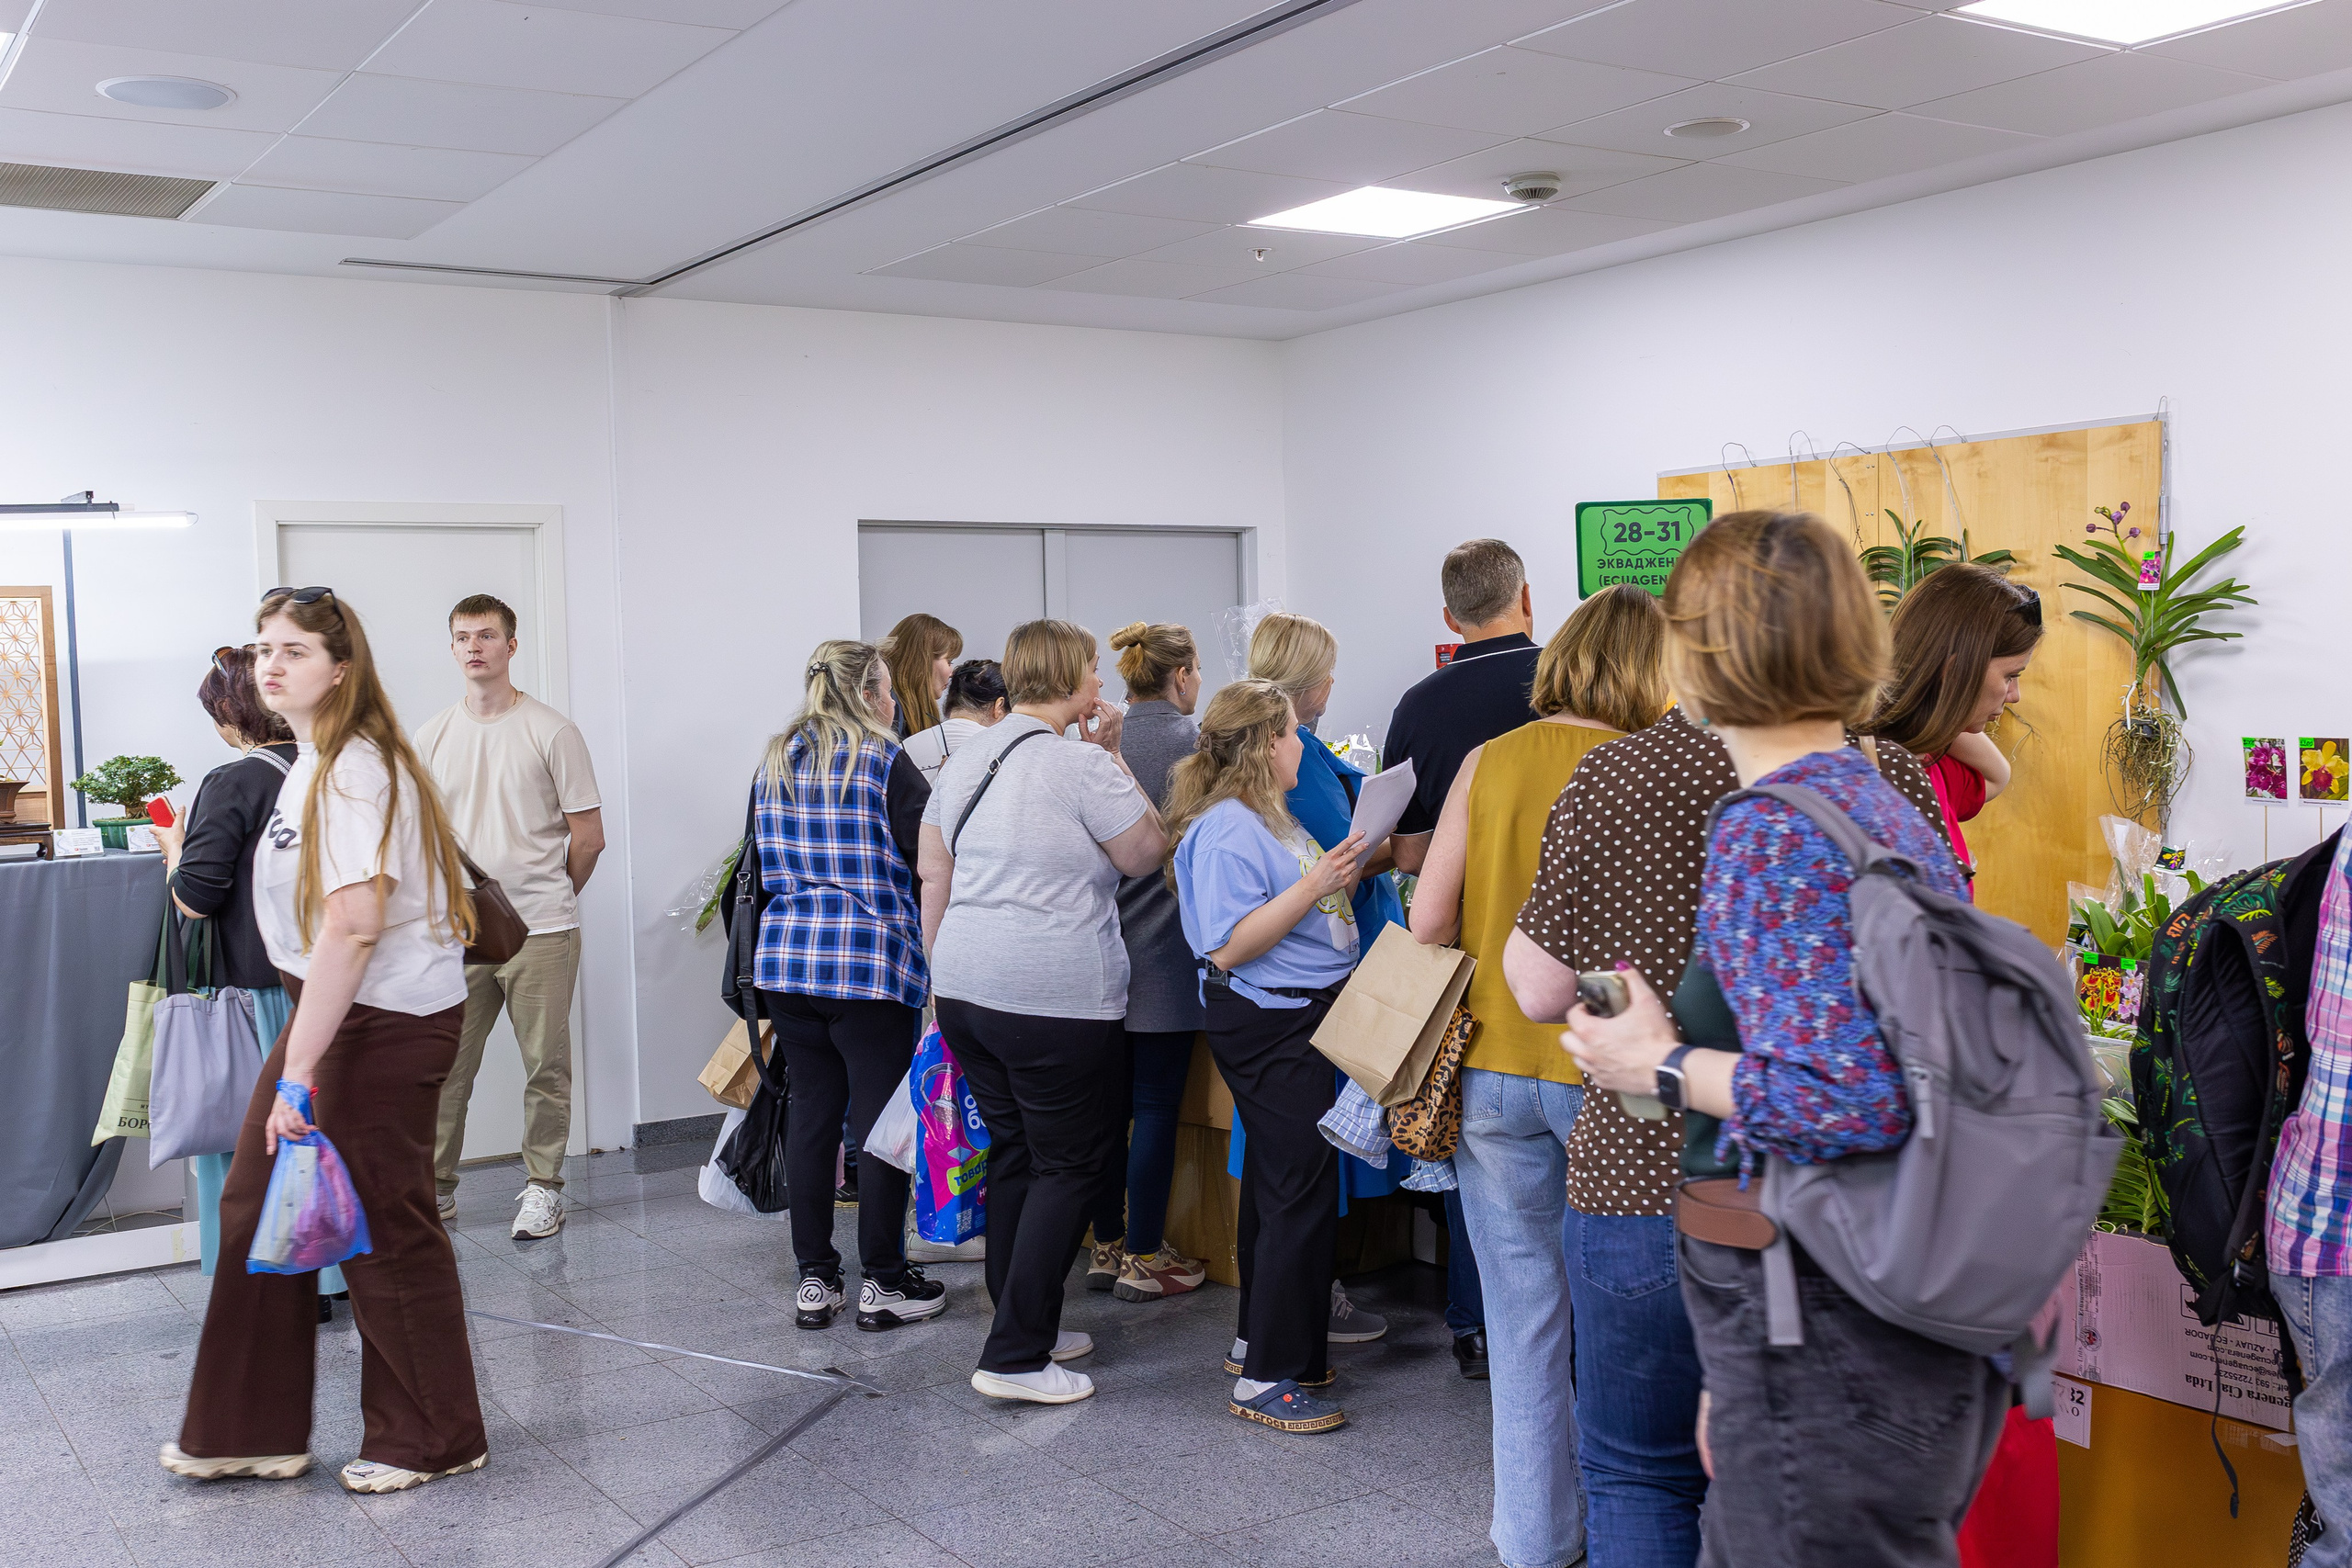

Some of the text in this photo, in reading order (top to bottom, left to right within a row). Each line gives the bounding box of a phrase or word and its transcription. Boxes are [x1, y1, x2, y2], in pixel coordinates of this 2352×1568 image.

[1613, 521, 1680, 543] 28-31
[1597, 558, 1677, 570] ЭКВАДЖЕН
[2235, 1340, 2266, 1353] AZUAY
[2207, 1345, 2278, 1366] ecuagenera.com
[2185, 1374, 2213, 1393] Ltda
[2256, 1378, 2270, 1388] 593
[1253, 1412, 1286, 1429] crocs
